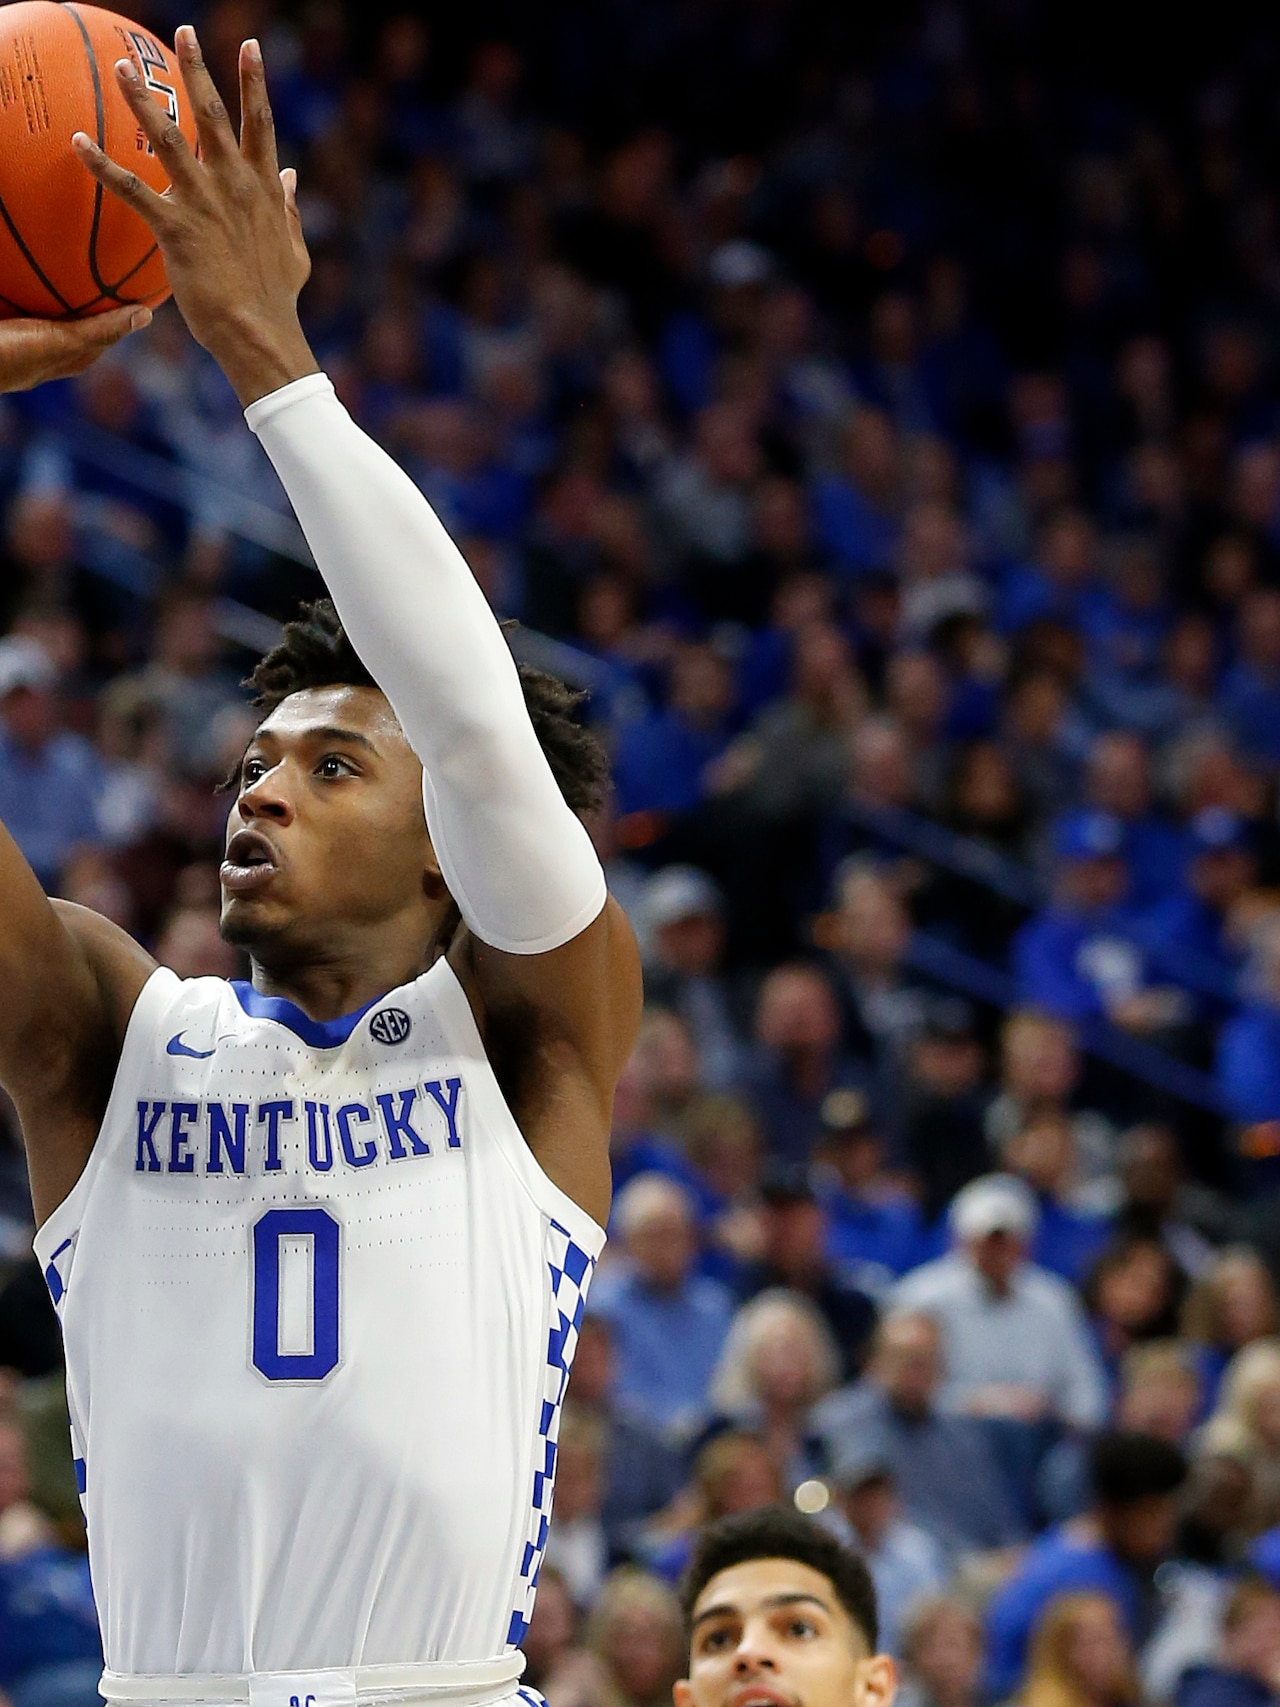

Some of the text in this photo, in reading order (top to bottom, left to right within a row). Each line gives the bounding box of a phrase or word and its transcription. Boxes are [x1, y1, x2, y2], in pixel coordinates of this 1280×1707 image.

[371, 1009, 409, 1043] SEC
[134, 1076, 464, 1174] KENTUCKY
[248, 1205, 344, 1385] 0
